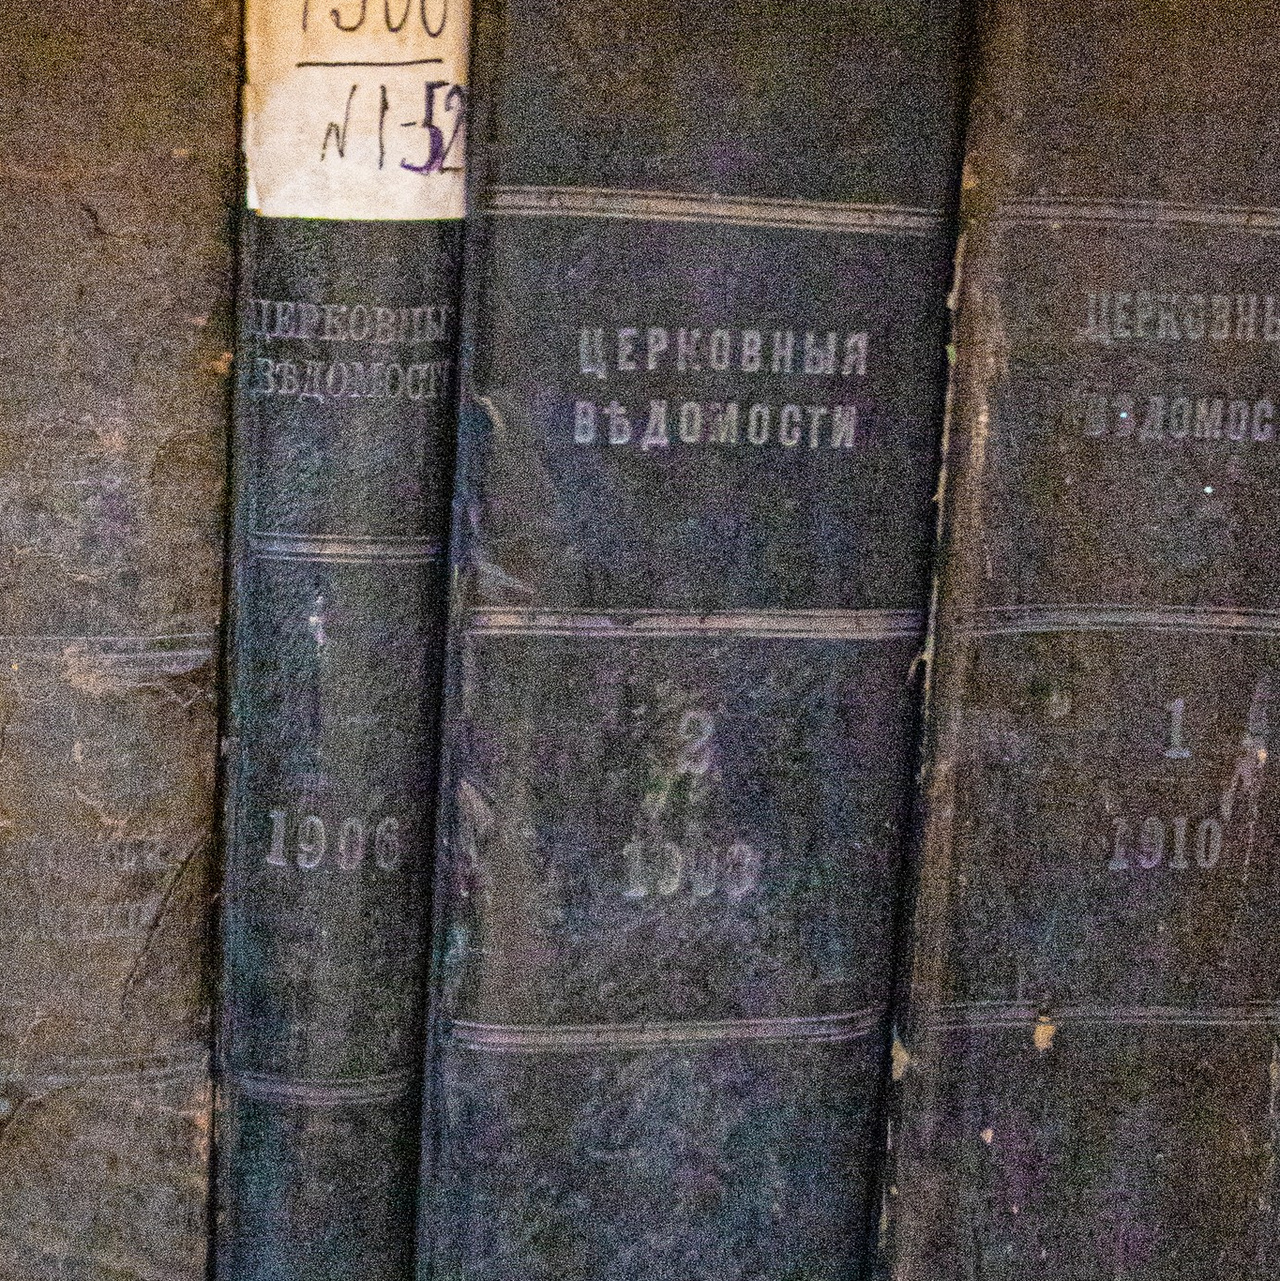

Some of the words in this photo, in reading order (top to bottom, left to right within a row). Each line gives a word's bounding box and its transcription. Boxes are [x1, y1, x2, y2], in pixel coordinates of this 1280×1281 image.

[1165, 697, 1193, 760] 1
[265, 809, 401, 872] 1906
[1108, 816, 1223, 871] 1910
